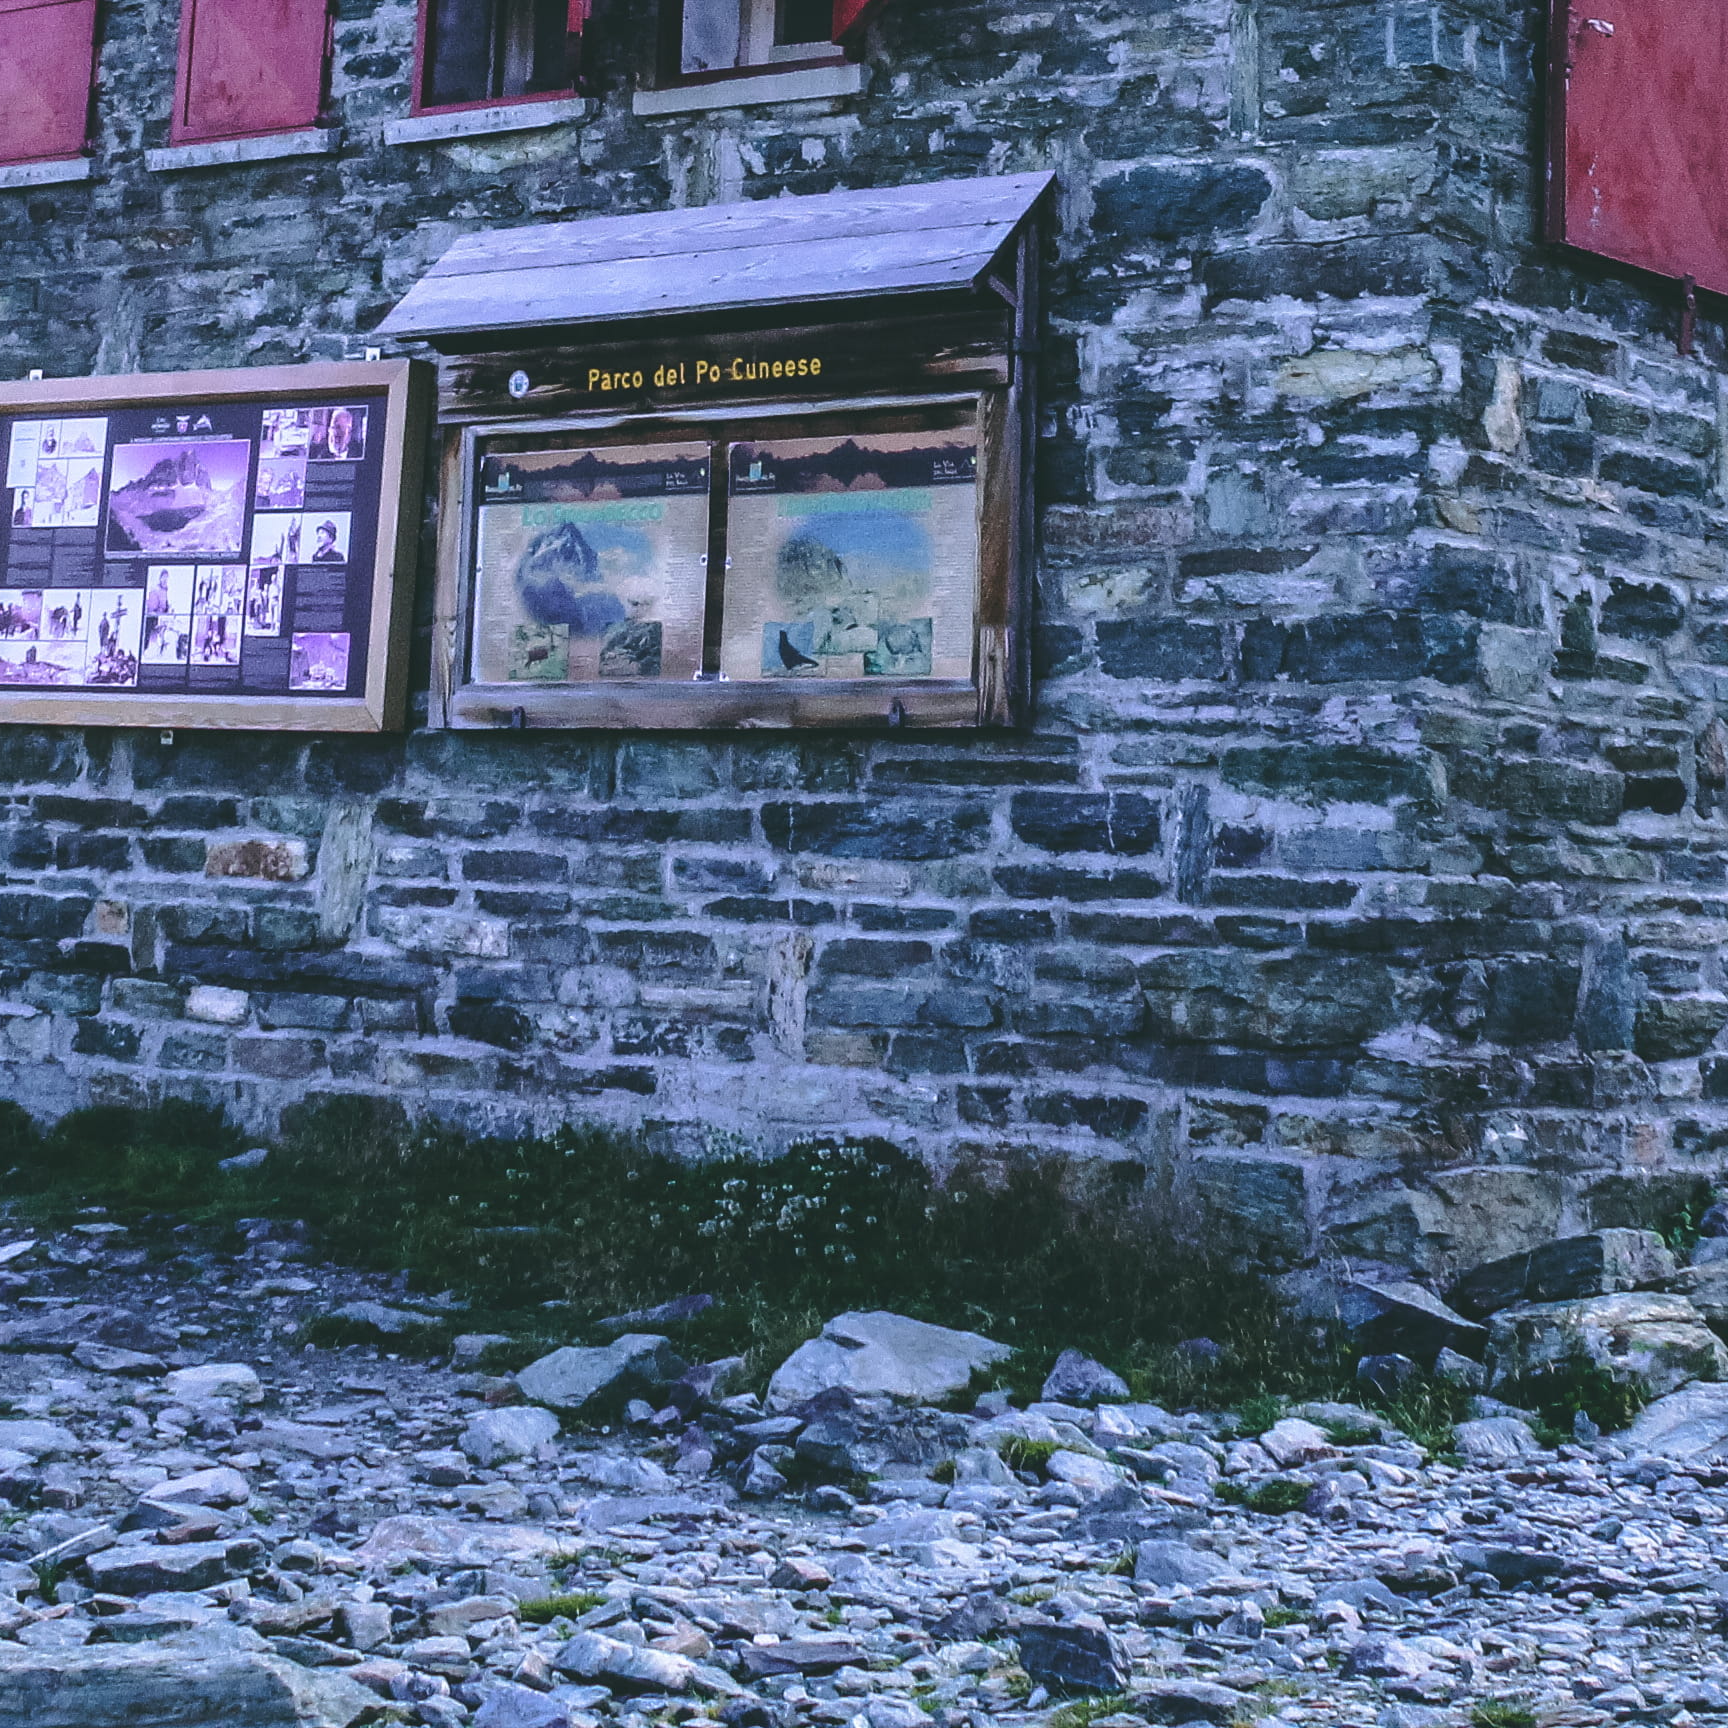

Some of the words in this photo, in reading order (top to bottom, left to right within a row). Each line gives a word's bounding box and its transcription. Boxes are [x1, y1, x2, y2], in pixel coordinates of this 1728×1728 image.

[588, 368, 643, 391] Parco
[653, 364, 685, 387] del
[696, 360, 721, 383] Po
[729, 357, 822, 381] Cuneese
